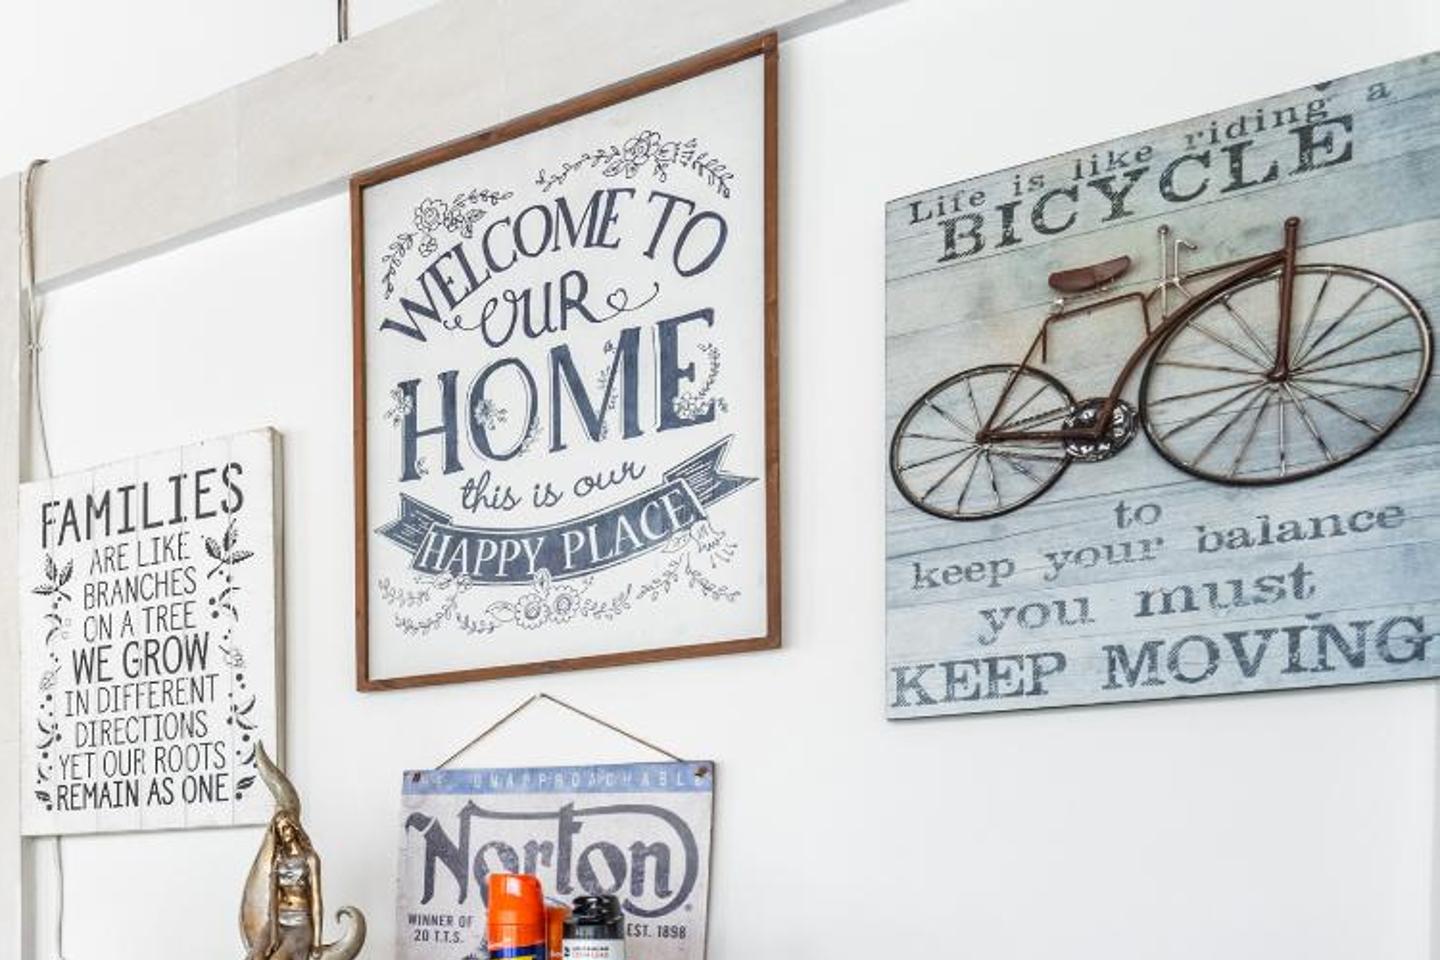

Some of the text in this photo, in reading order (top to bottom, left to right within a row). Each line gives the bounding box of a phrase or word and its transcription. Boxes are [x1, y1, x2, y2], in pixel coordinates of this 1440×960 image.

[909, 82, 1392, 225] Life is like riding a
[937, 113, 1355, 263] BICYCLE
[379, 188, 729, 342] WELCOME TO
[398, 308, 716, 482] HOME
[41, 462, 245, 549] FAMILIES
[461, 458, 647, 514] this is our
[420, 486, 696, 578] HAPPY PLACE
[1113, 498, 1162, 530] to
[90, 532, 191, 575] ARE LIKE
[911, 504, 1406, 592] keep your balance
[84, 565, 198, 611] BRANCHES
[977, 561, 1317, 646] you must
[84, 601, 197, 642] ON A TREE
[72, 631, 210, 685] WE GROW
[890, 612, 1433, 708] KEEP MOVING
[64, 673, 220, 718] IN DIFFERENT
[75, 710, 209, 749] DIRECTIONS
[59, 741, 227, 782] YET OUR ROOTS
[56, 773, 230, 811] REMAIN AS ONE
[405, 799, 700, 919] Norton
[407, 912, 453, 926] WINNER
[414, 929, 429, 941] 20
[626, 922, 687, 939] EST. 1898
